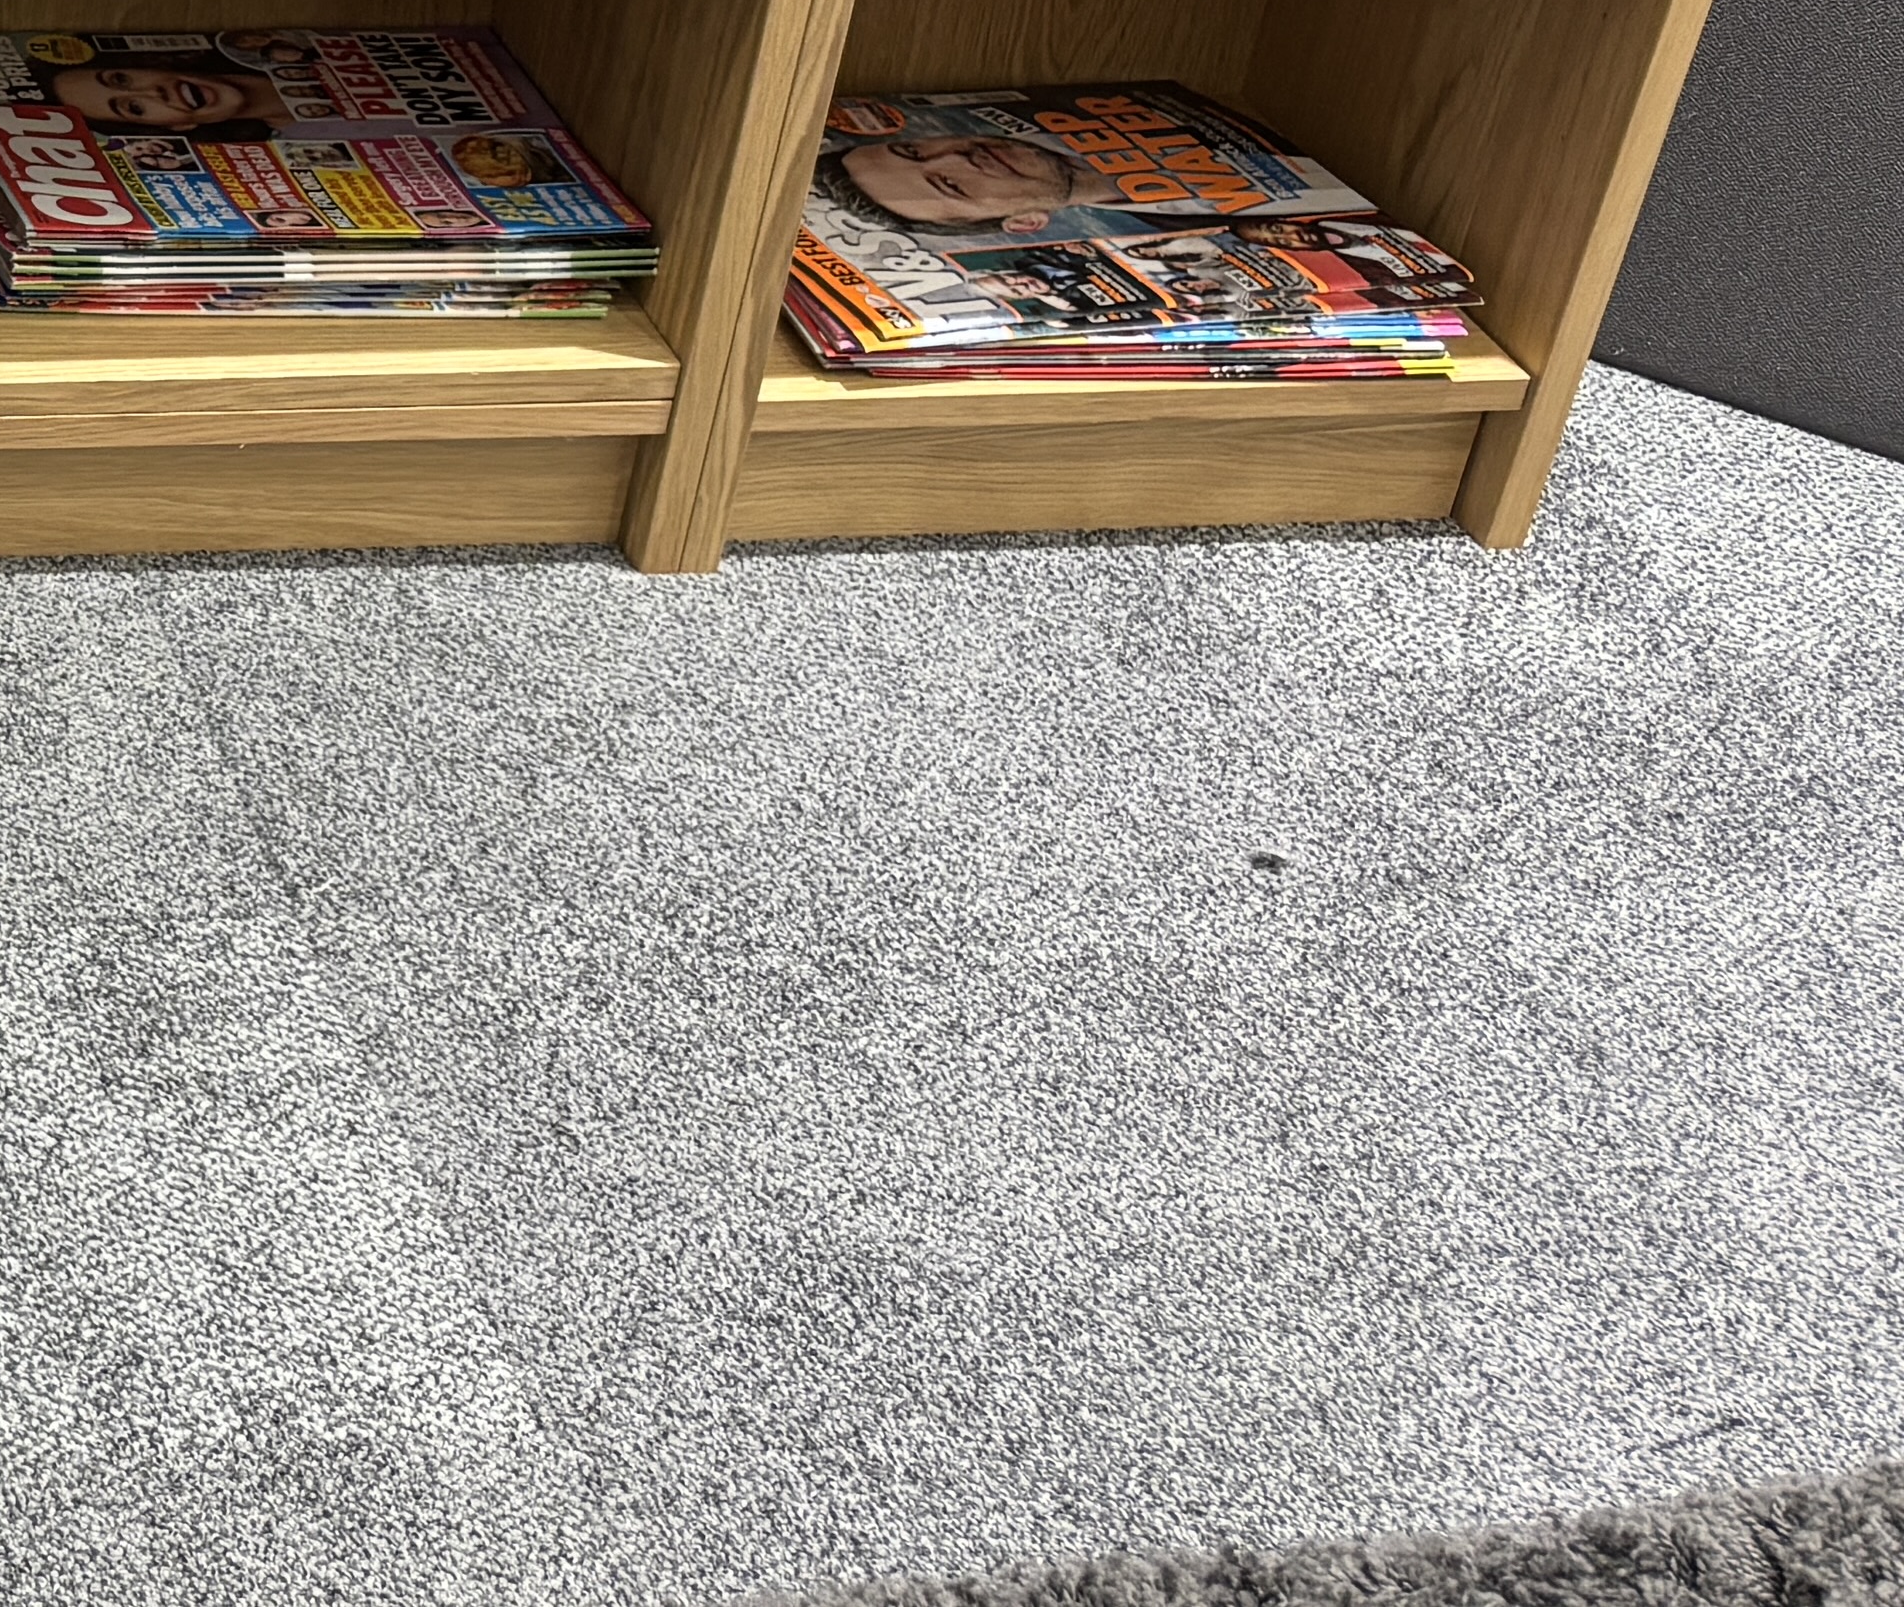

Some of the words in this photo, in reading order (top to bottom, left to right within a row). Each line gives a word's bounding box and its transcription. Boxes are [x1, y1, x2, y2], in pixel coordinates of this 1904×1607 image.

[353, 34, 414, 70] TAKE
[389, 36, 468, 82] SON!
[15, 88, 47, 100] &
[311, 38, 411, 115] PLEASE
[383, 73, 454, 124] DON'T
[429, 87, 499, 121] MY
[976, 108, 1034, 134] NEW
[1034, 109, 1192, 203] DEEP
[1075, 94, 1268, 215] WATER
[812, 257, 869, 285] BEST
